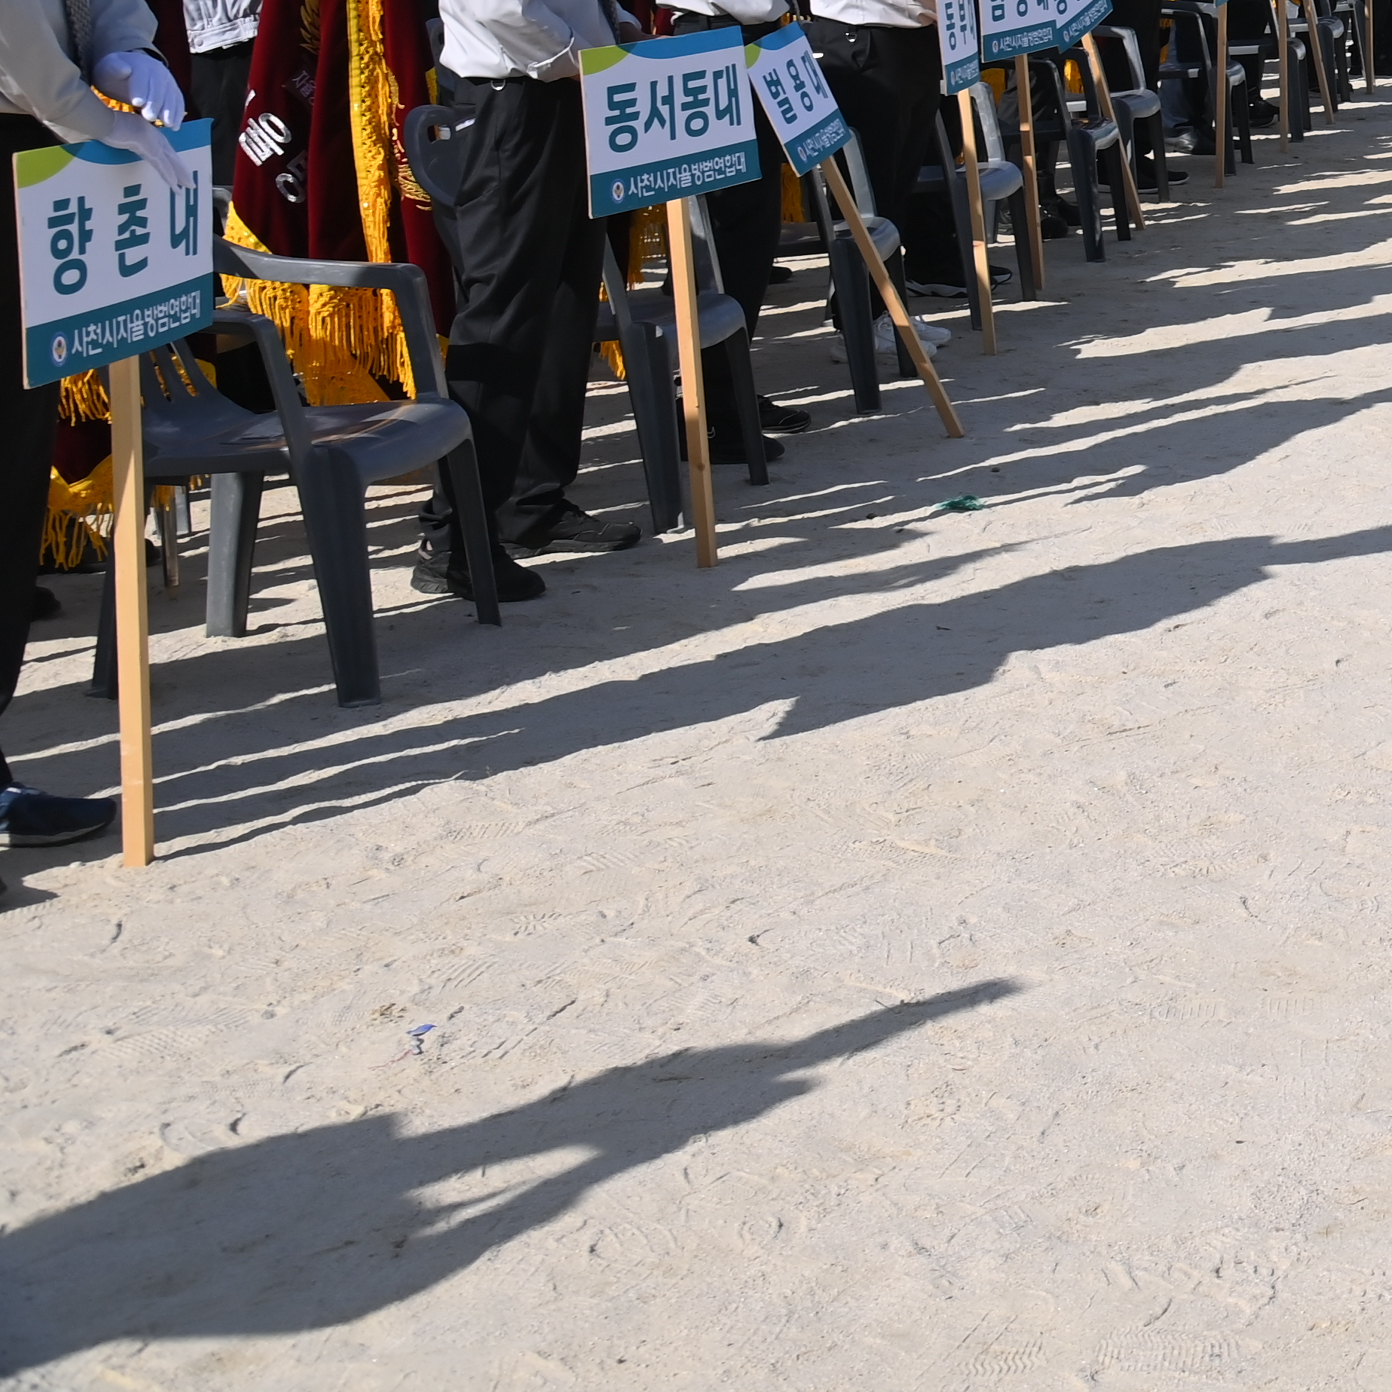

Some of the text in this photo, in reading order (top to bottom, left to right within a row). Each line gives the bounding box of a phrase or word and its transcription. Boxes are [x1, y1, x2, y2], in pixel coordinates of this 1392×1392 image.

[604, 63, 742, 154] 동서동대
[762, 49, 829, 125] 벌용대
[628, 151, 747, 198] 사천시자율방범연합대
[71, 290, 201, 357] 사천시자율방범연합대
